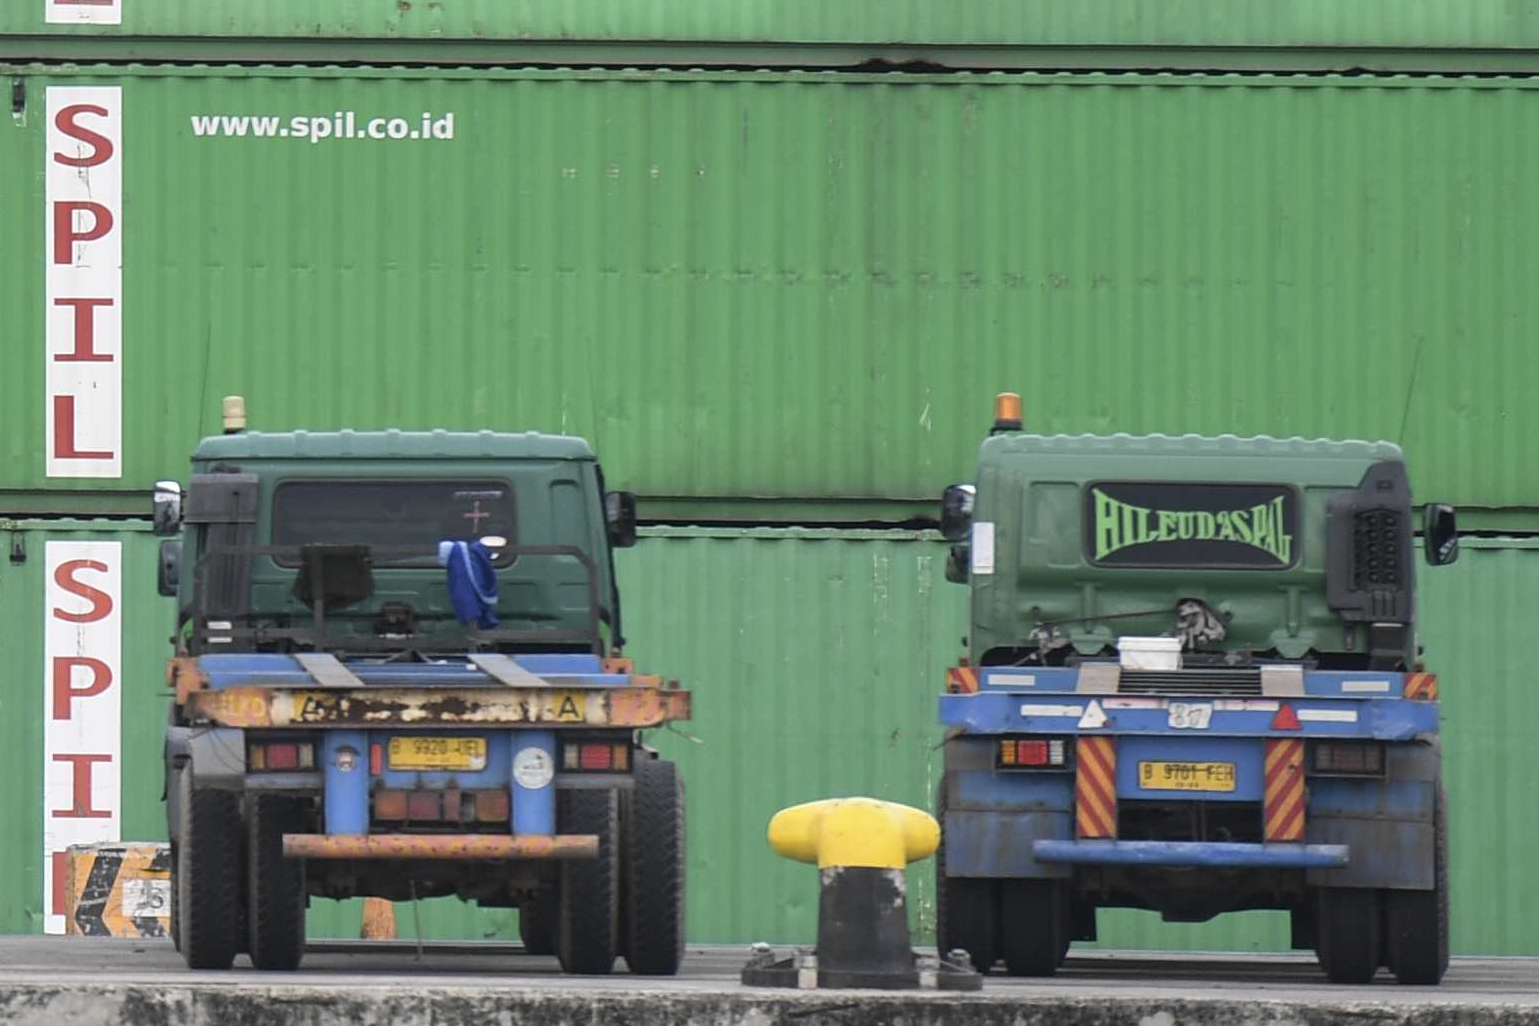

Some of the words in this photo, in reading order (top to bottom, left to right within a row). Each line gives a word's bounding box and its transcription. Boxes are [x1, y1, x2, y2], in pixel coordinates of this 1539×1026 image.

[191, 112, 454, 143] www.spil.co.id
[54, 104, 114, 459] SPIL
[558, 696, 580, 719] A
